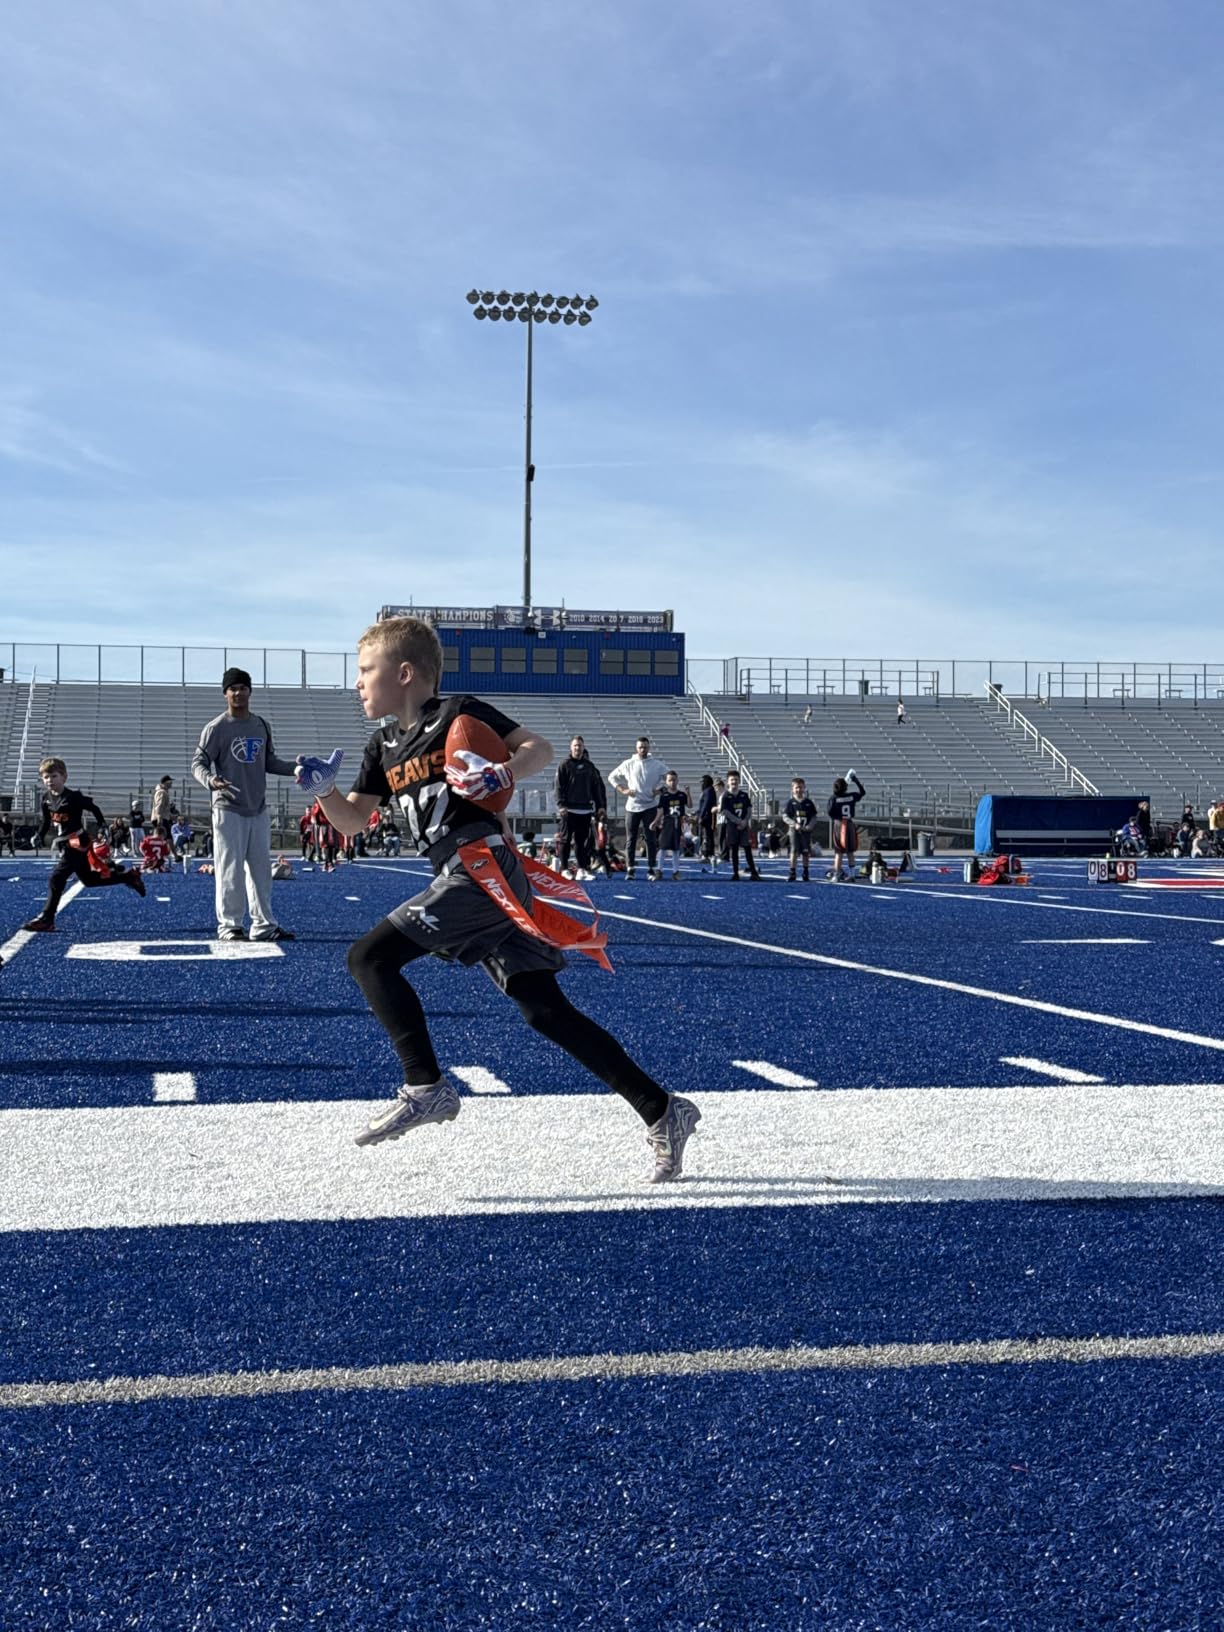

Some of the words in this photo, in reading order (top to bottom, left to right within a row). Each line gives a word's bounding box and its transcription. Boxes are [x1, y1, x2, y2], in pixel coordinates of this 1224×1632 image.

[608, 615, 624, 623] 207
[841, 804, 851, 819] 9
[1089, 861, 1107, 878] 08
[1116, 861, 1136, 878] 08
[525, 871, 568, 892] NEXT
[480, 878, 520, 917] NEXT
